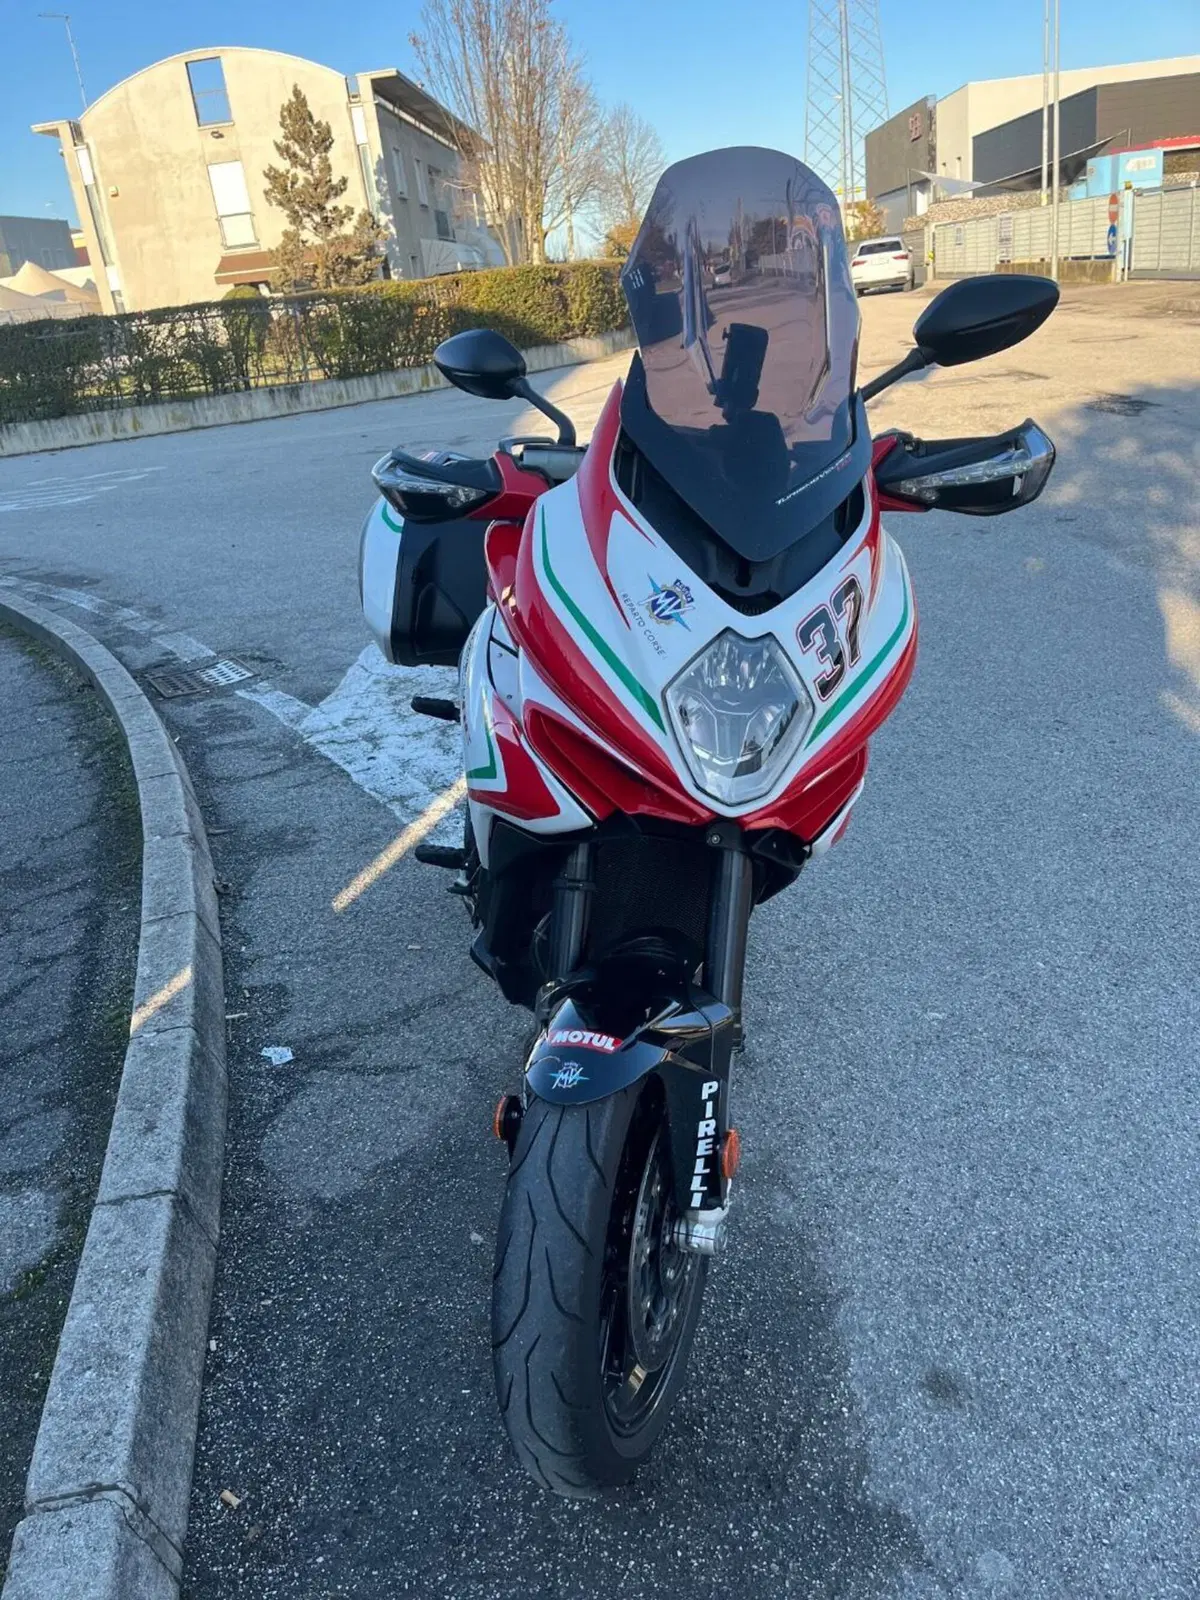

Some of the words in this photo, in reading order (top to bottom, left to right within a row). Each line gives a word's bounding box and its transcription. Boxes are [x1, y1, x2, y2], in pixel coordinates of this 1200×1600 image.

[622, 593, 646, 627] REPARTO
[643, 629, 666, 655] CORSE
[795, 573, 864, 701] 37
[552, 1031, 615, 1051] MOTUL
[690, 1081, 718, 1207] PIRELLI
